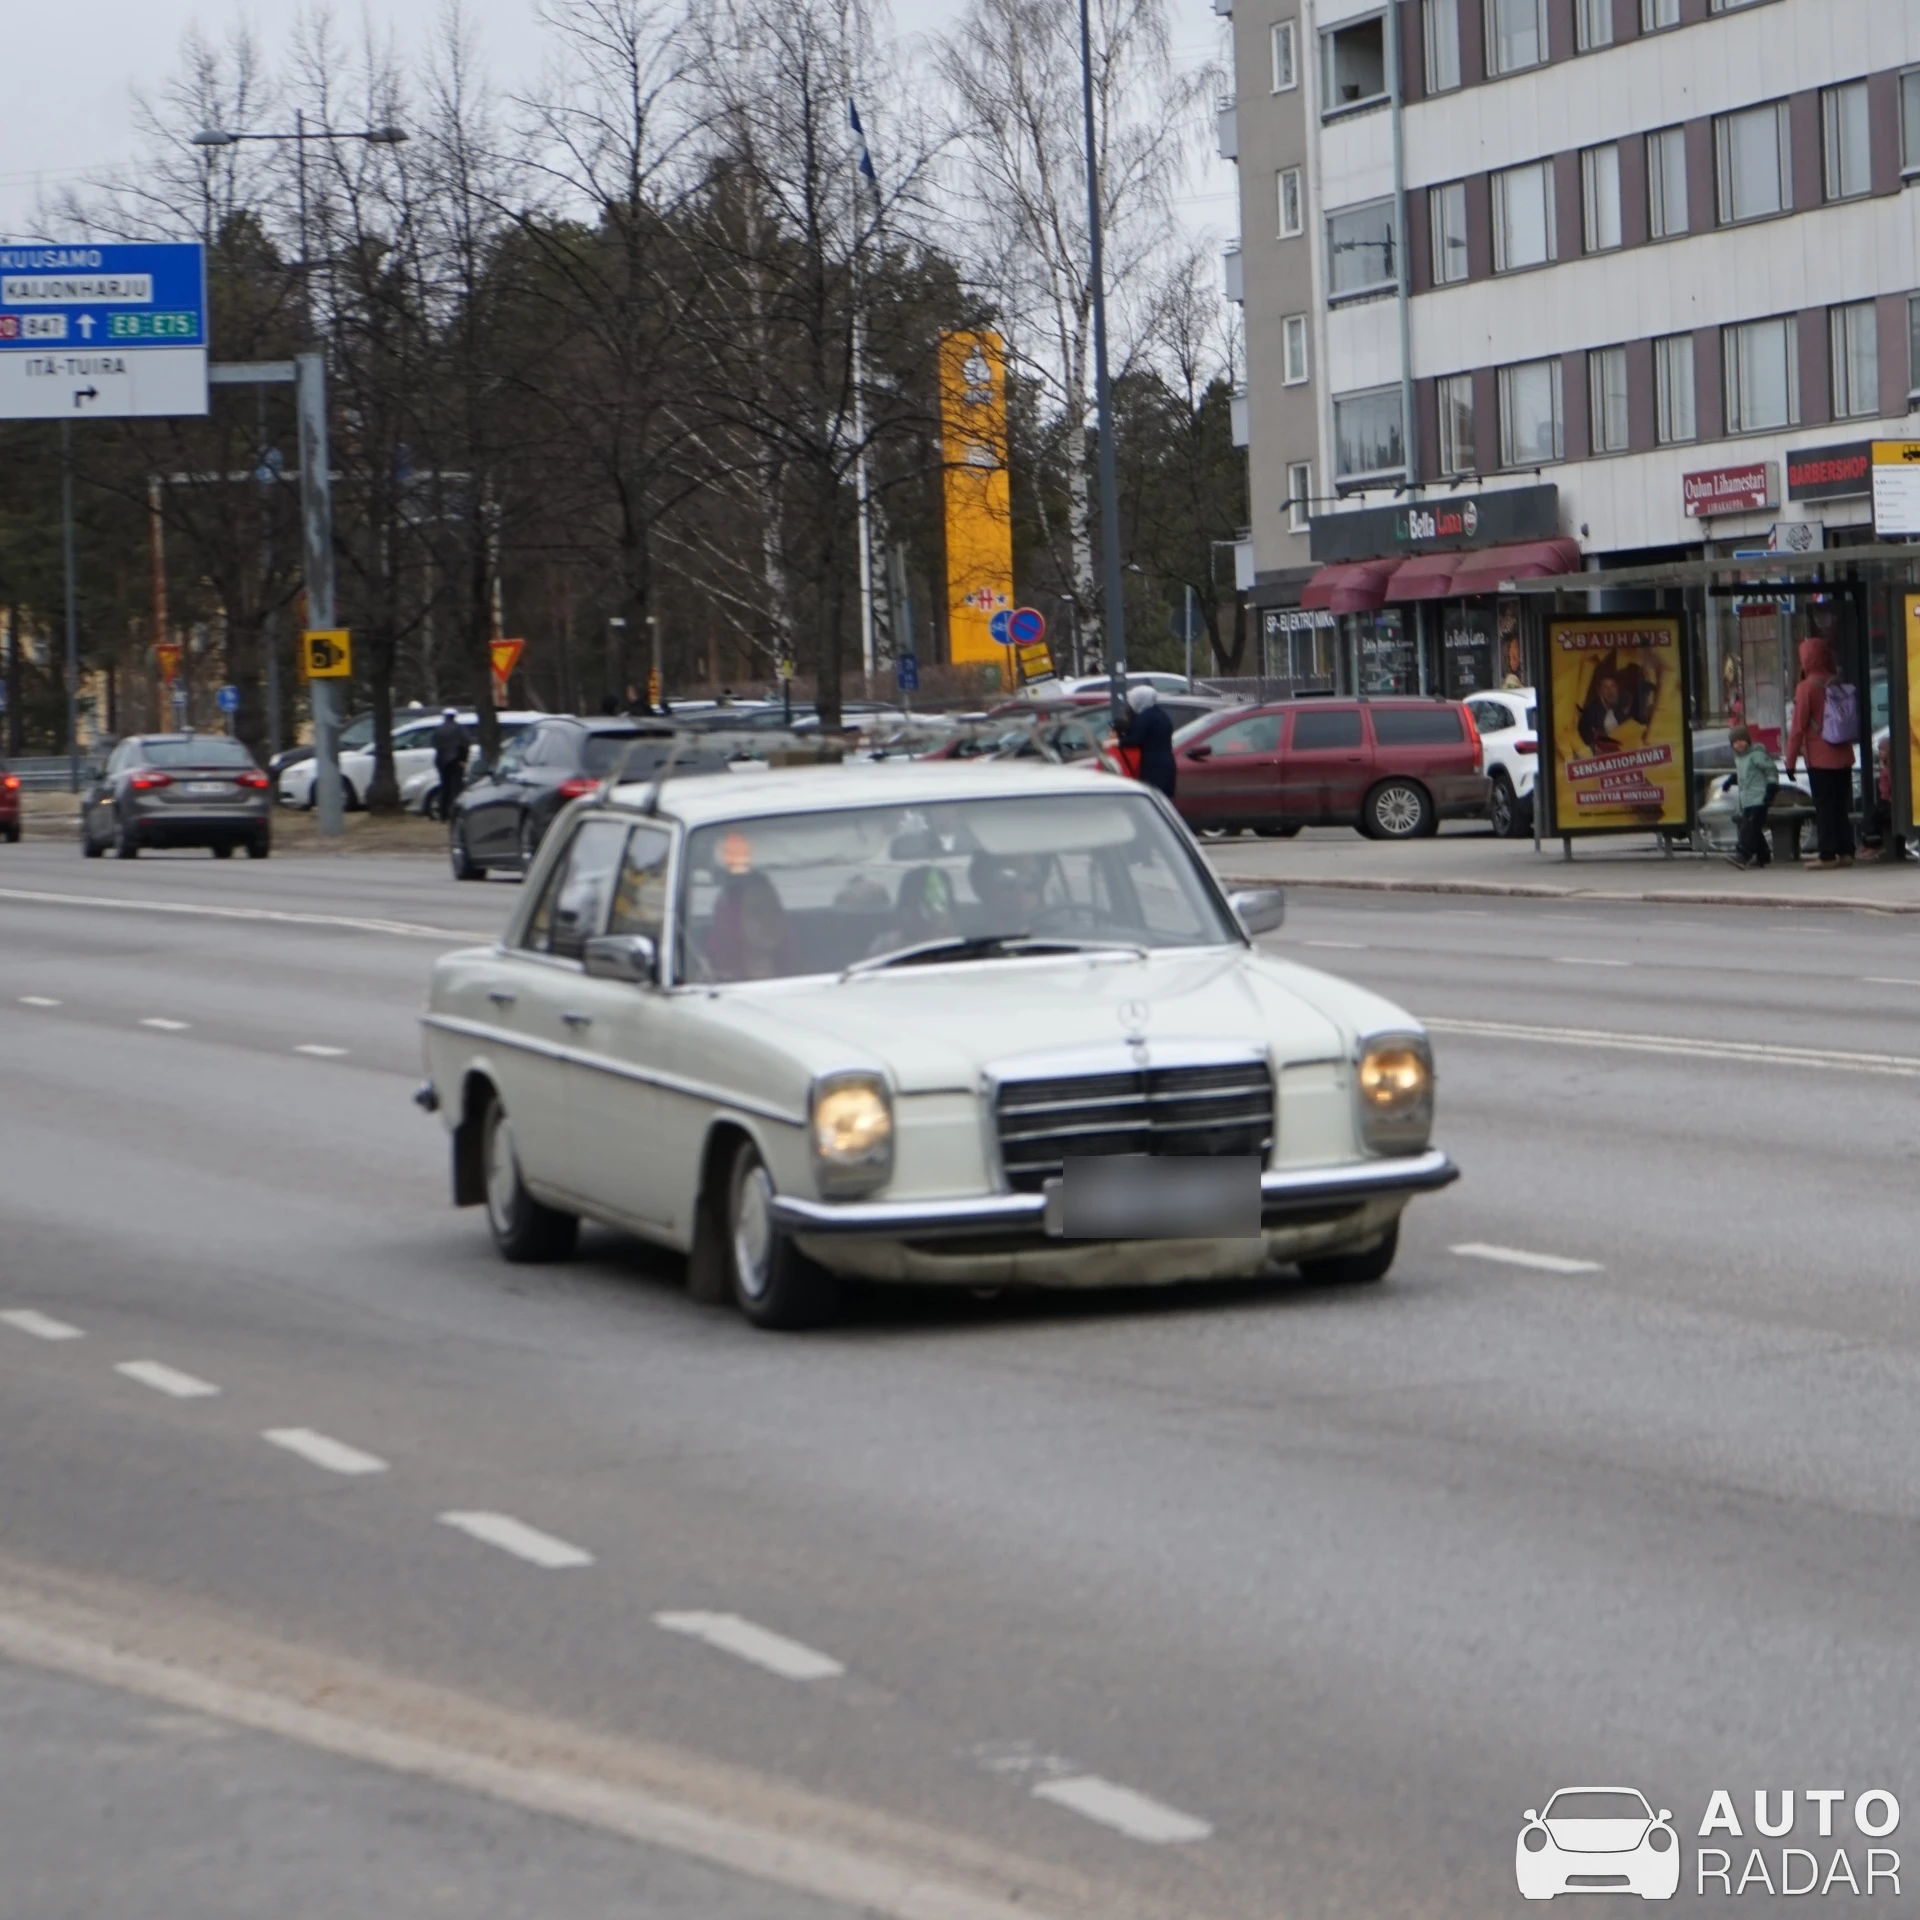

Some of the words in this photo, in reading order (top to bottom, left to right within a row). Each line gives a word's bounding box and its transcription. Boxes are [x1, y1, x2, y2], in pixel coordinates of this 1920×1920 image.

[0, 250, 102, 268] KUUSAMO
[153, 315, 189, 334] E75
[26, 357, 126, 376] ITÄ-TUIRA
[1685, 477, 1713, 499] Oulun
[1714, 468, 1765, 495] Lihamestari
[1789, 456, 1868, 487] BARBERSHOP
[1409, 509, 1436, 540] Bella
[1572, 748, 1665, 777] SENSAATIOPÄIVÄT
